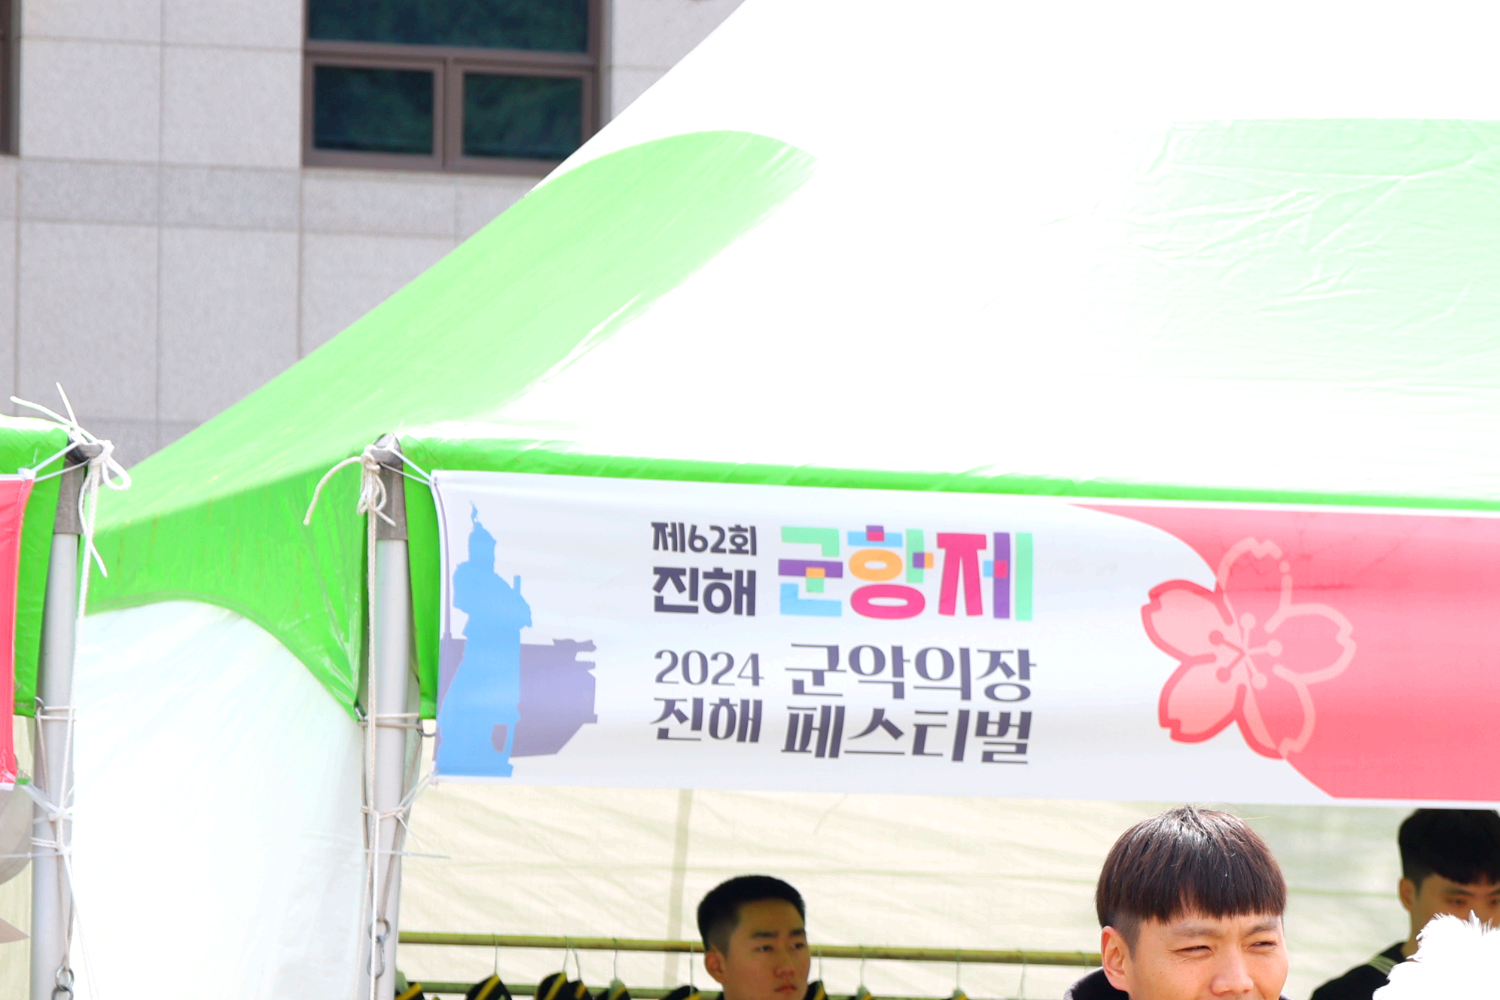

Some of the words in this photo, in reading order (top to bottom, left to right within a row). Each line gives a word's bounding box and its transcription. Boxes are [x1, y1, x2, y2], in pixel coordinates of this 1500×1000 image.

[651, 521, 758, 557] 제62회
[652, 565, 758, 617] 진해
[778, 525, 1034, 622] 군항제
[653, 649, 765, 687] 2024
[784, 643, 1037, 703] 군악의장
[650, 697, 763, 743] 진해
[781, 705, 1034, 764] 페스티벌
